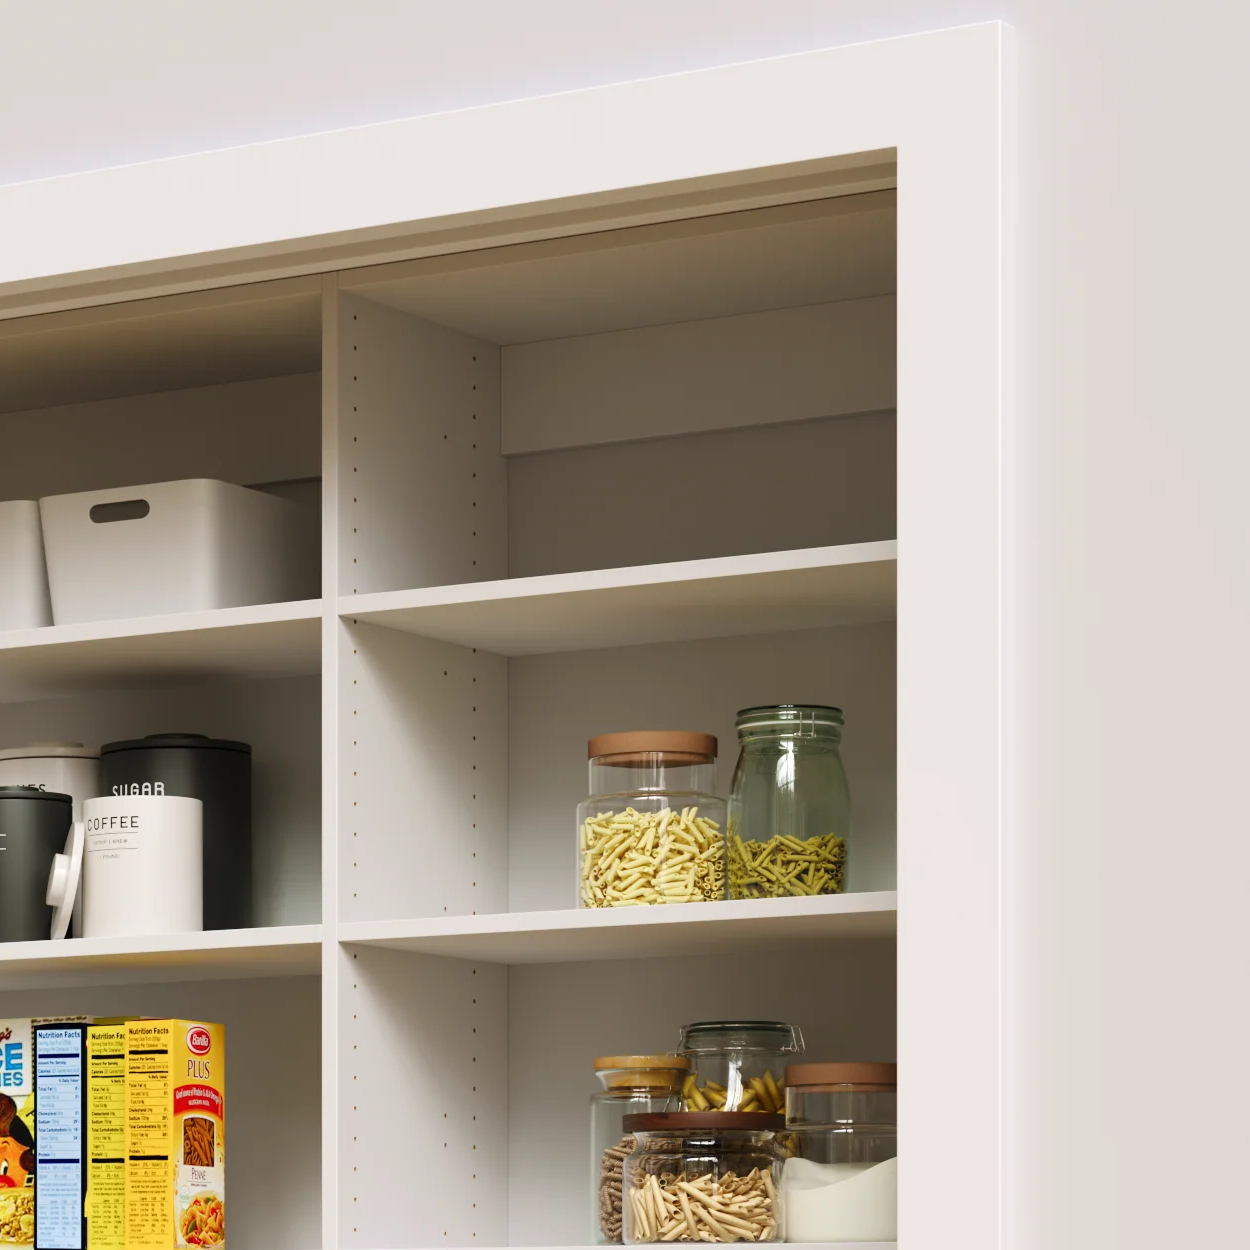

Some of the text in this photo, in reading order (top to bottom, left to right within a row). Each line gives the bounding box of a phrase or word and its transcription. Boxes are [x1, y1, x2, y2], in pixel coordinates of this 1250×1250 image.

[112, 782, 164, 796] SUGAR
[88, 816, 138, 832] COFFEE
[192, 1034, 208, 1046] Barilla
[187, 1059, 210, 1079] PLUS
